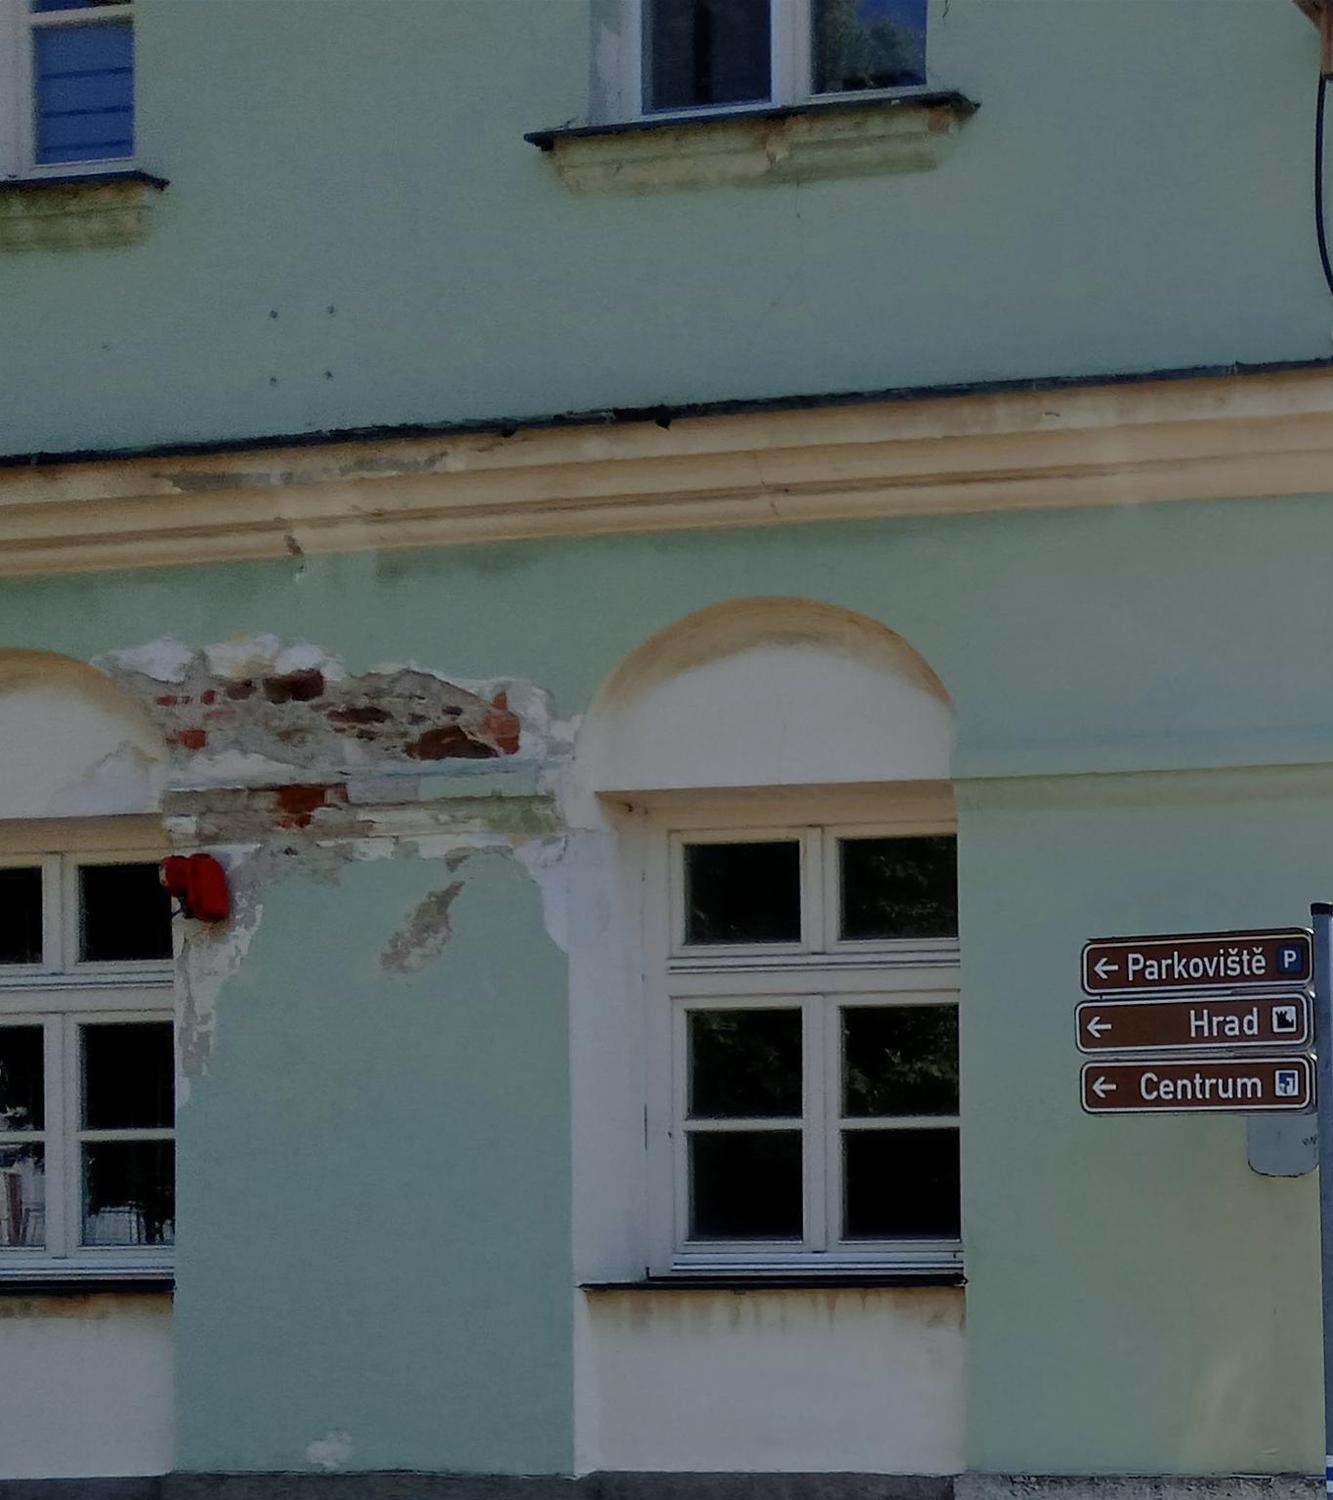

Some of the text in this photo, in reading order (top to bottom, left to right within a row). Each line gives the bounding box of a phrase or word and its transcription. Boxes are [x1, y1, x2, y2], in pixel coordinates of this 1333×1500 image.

[1127, 947, 1297, 981] Parkoviště P
[1190, 1007, 1259, 1038] Hrad
[1140, 1073, 1262, 1100] Centrum
